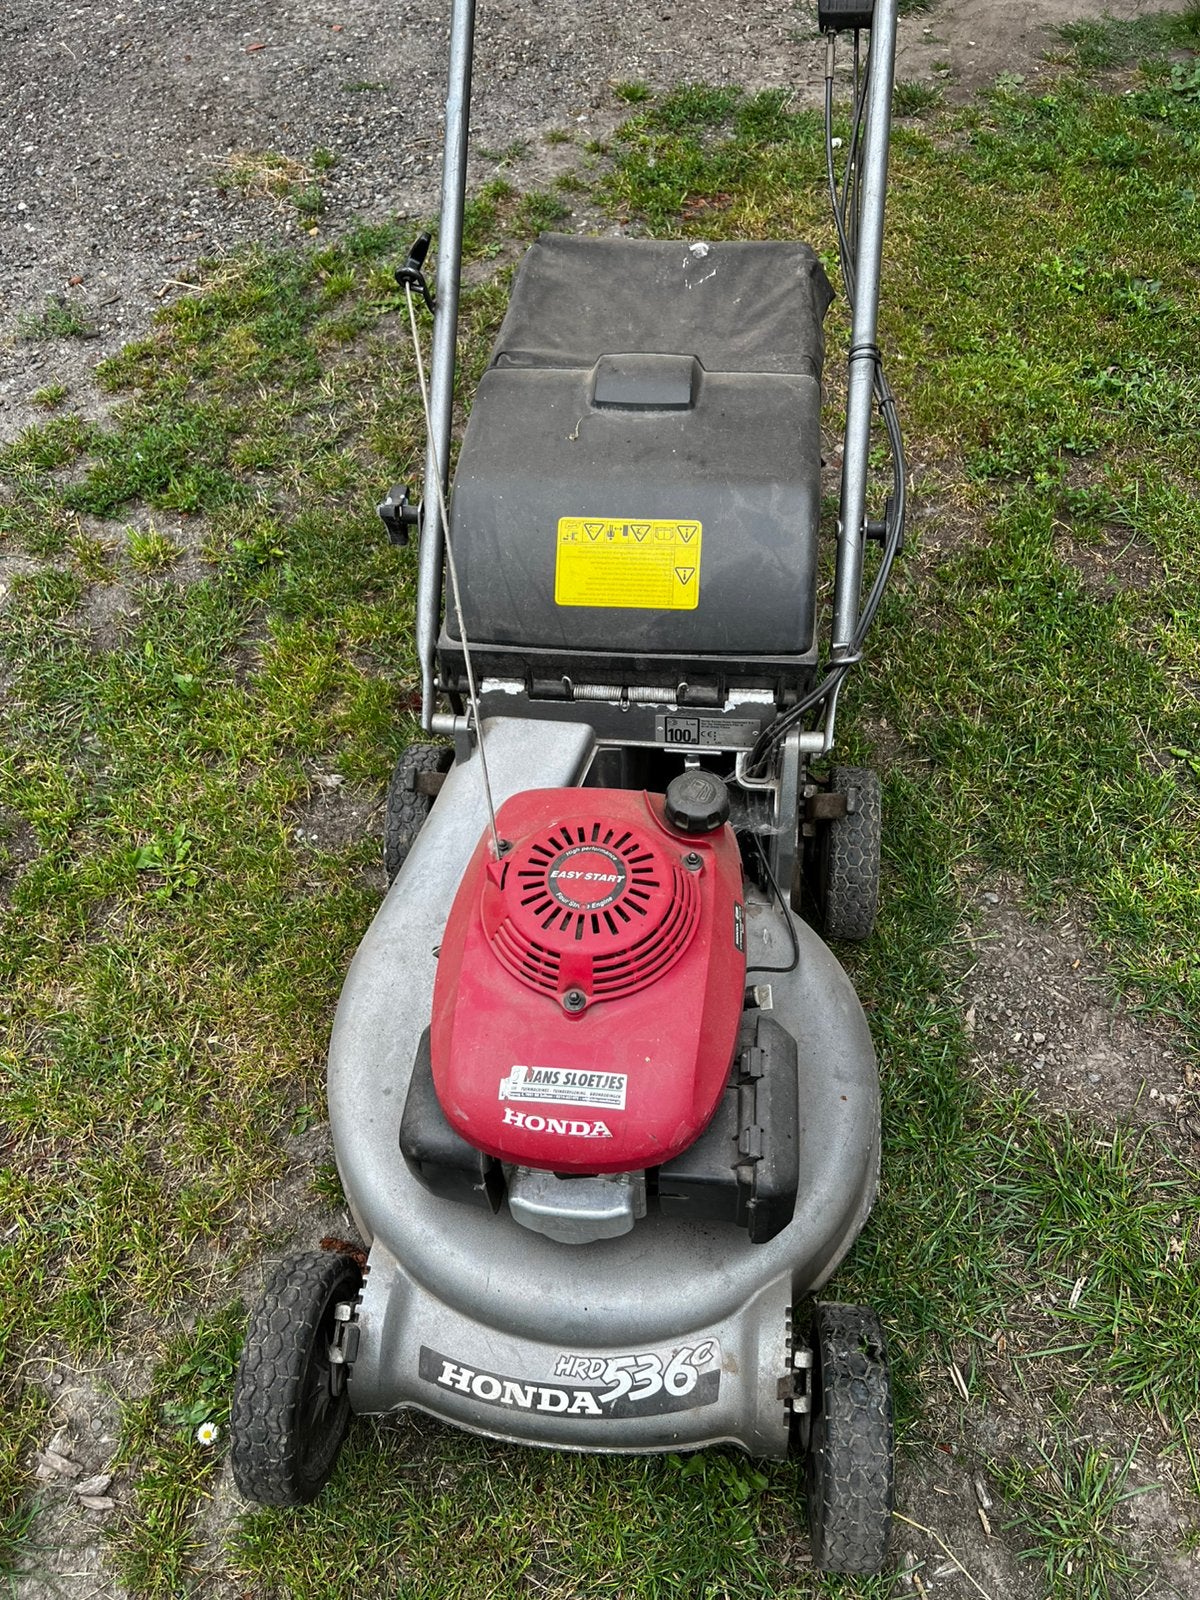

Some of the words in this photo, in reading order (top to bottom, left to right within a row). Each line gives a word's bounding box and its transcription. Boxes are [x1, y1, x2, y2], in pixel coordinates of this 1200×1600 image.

[668, 728, 691, 742] 100
[550, 870, 584, 880] EASY
[584, 872, 626, 883] START
[591, 896, 613, 909] Engine
[562, 1072, 625, 1090] SLOETJES
[502, 1107, 613, 1138] HONDA
[437, 1360, 603, 1415] HONDA
